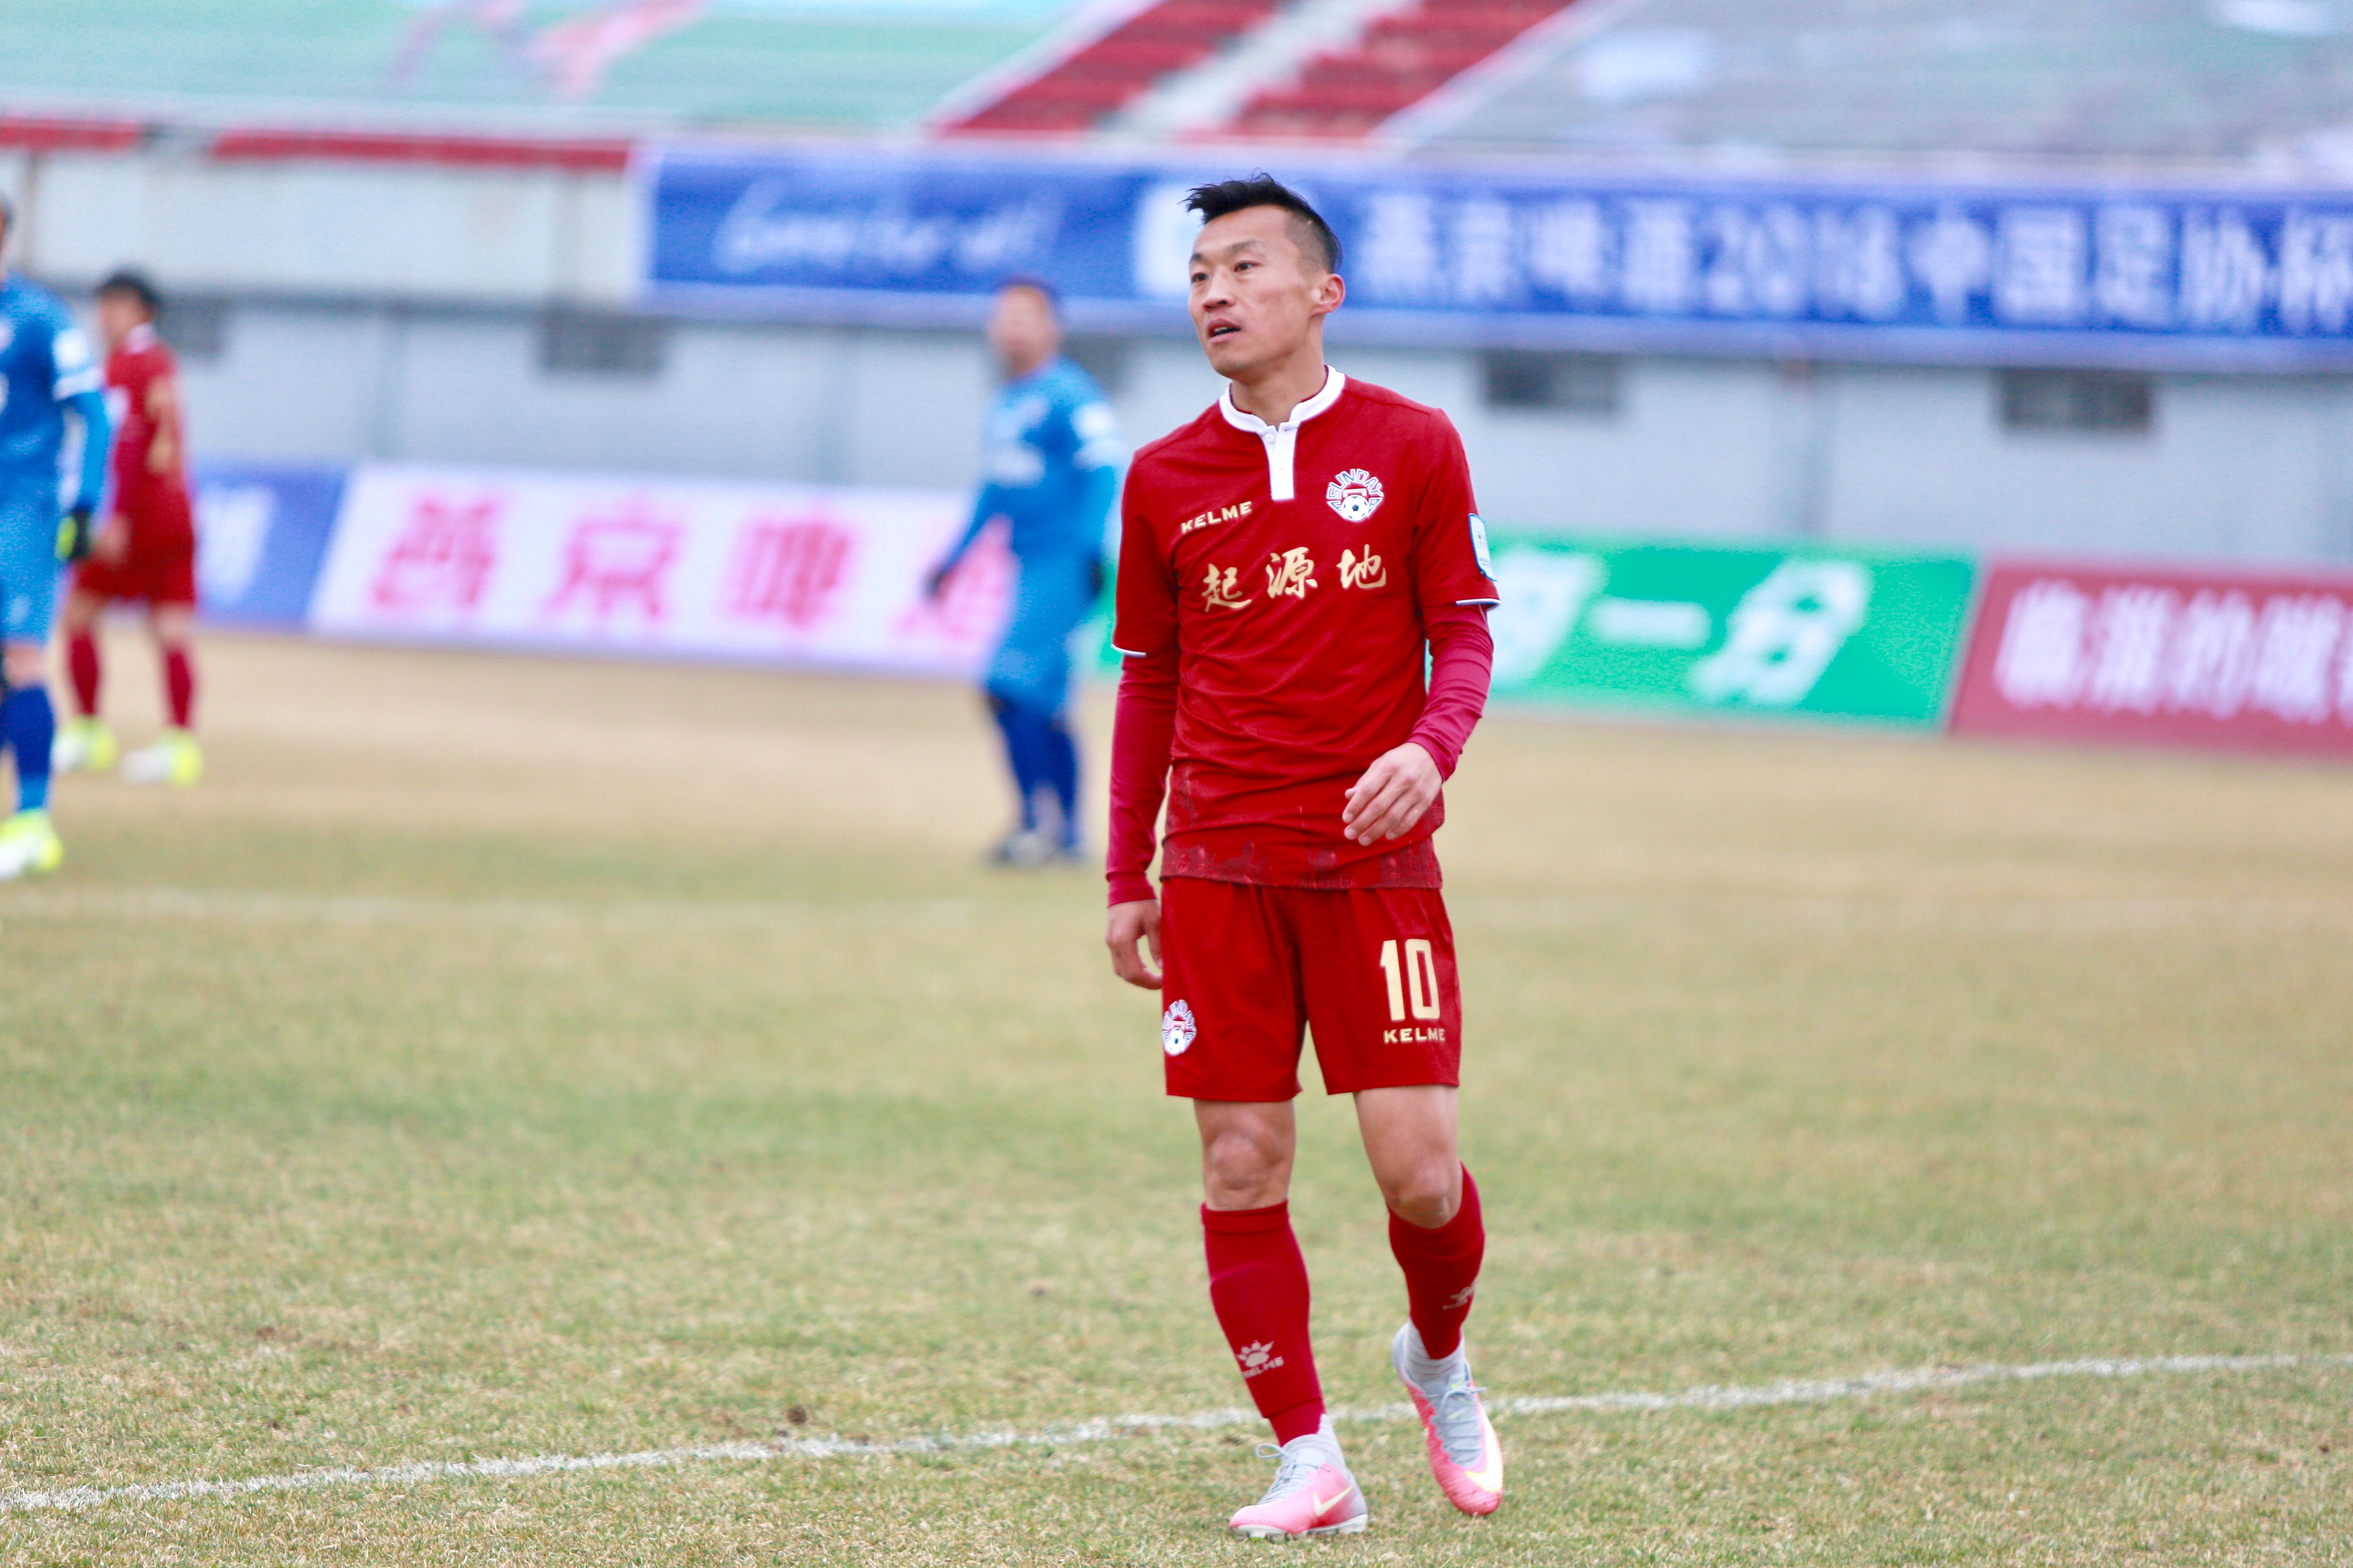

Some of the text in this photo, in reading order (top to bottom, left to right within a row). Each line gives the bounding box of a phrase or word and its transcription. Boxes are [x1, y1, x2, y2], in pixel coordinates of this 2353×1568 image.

[1326, 468, 1384, 499] SUNDAY
[1181, 501, 1251, 535] KELME
[1201, 544, 1387, 612] 起源地
[1380, 939, 1440, 1021] 10
[1383, 1028, 1445, 1044] KELME
